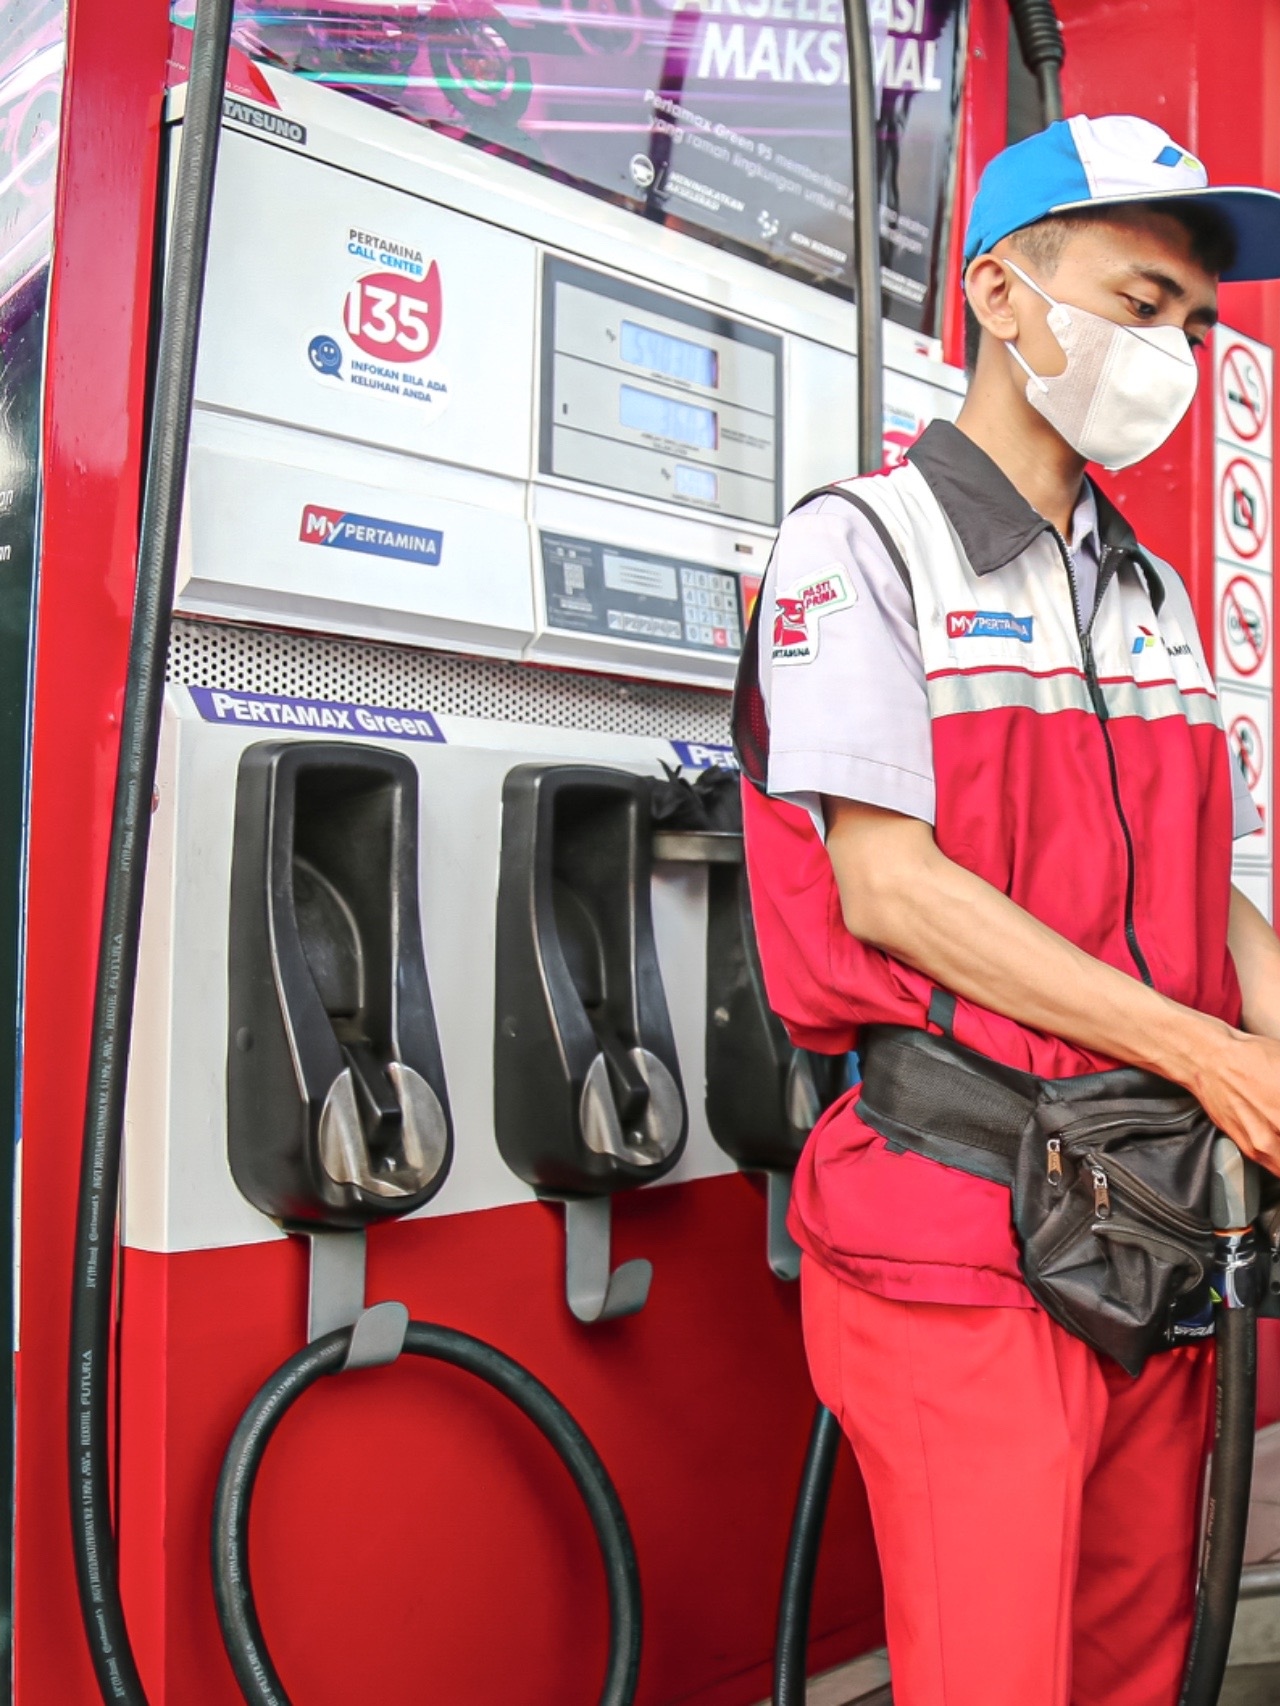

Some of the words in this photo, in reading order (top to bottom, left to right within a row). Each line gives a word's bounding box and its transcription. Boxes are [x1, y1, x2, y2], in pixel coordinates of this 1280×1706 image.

[223, 102, 303, 141] TATSUNO
[644, 89, 713, 132] Pertamax
[713, 123, 755, 152] Green
[686, 133, 731, 162] ramah
[347, 243, 376, 261] CALL
[379, 253, 423, 276] CENTER
[349, 229, 423, 263] PERTAMINA
[348, 282, 430, 353] 135
[350, 374, 399, 395] KELUHAN
[402, 388, 432, 403] ANDA
[351, 360, 399, 381] INFOKAN
[402, 372, 424, 388] BILA
[427, 379, 447, 393] ADA
[305, 513, 437, 555] MyPERTAMINA
[211, 692, 355, 731] PERTAMAX
[354, 708, 435, 737] Green
[108, 933, 123, 989] FUTURA
[80, 1349, 92, 1406] FUTURA
